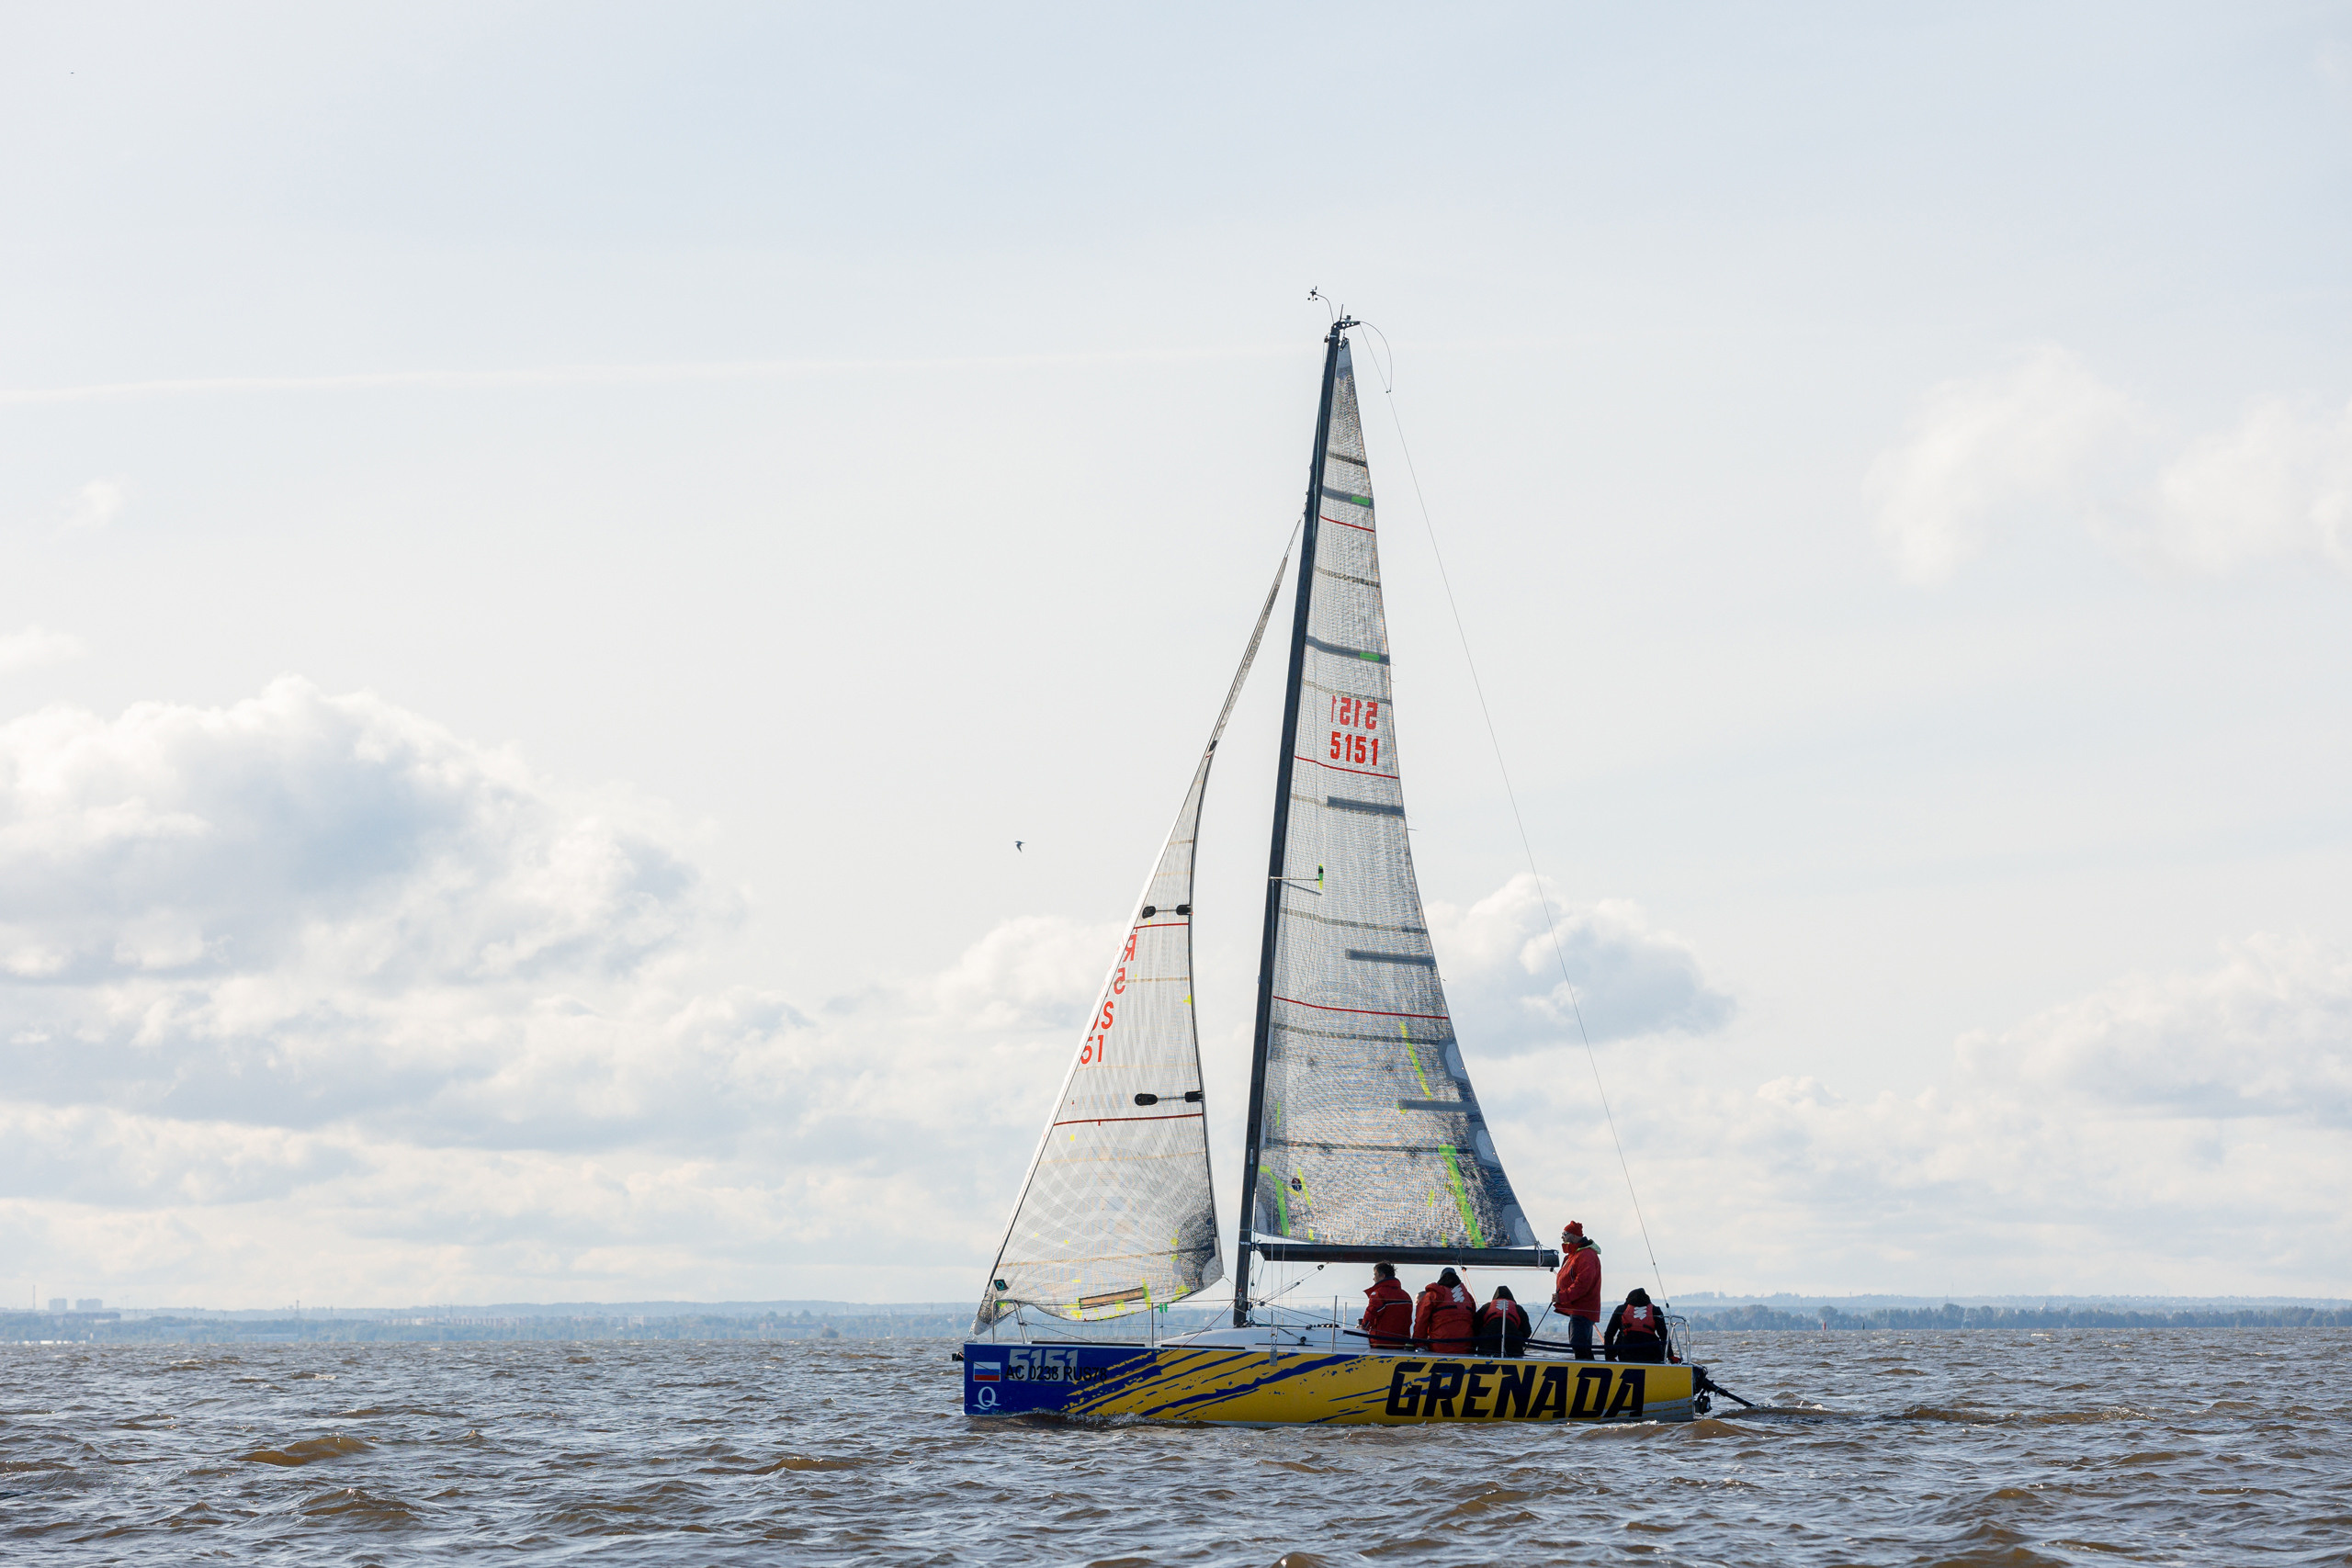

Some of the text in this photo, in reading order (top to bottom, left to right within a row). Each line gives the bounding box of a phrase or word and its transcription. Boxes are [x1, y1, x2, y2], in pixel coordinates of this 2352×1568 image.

[1330, 731, 1379, 766] 5151
[1008, 1348, 1079, 1382] 5151
[1385, 1361, 1646, 1419] GRENADA
